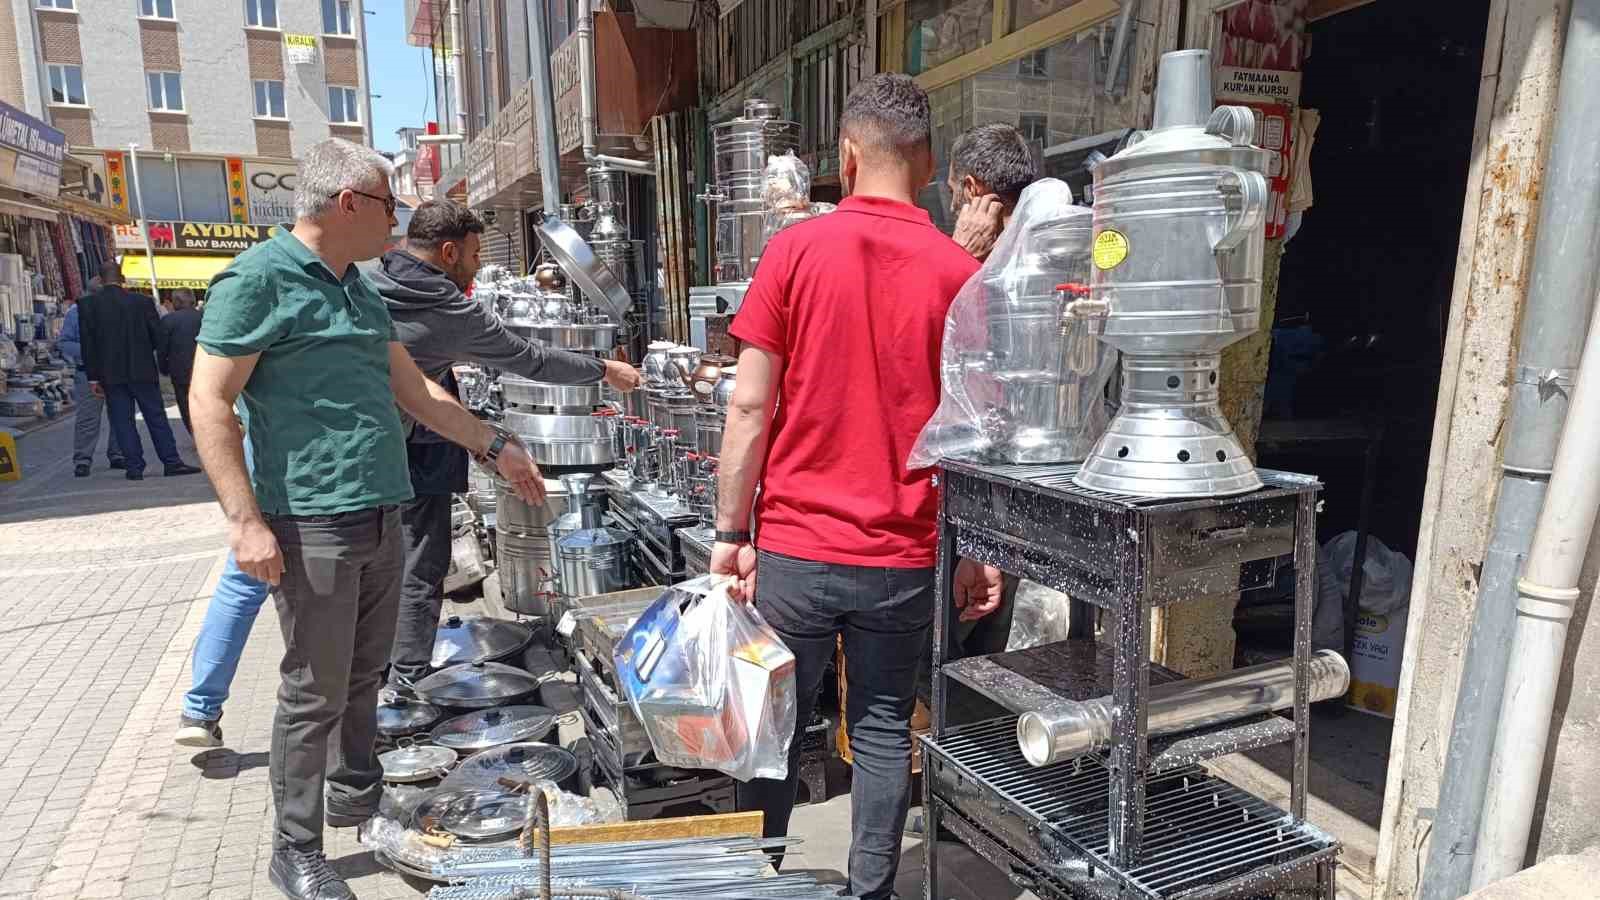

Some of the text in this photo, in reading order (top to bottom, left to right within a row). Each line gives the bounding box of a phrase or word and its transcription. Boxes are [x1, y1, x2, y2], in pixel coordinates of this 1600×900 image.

[1233, 71, 1280, 84] FATMAANA
[1223, 82, 1289, 96] KUR'AN KURSU
[182, 223, 259, 239] AYDIN
[185, 239, 209, 248] BAY
[211, 240, 248, 249] BAYAN
